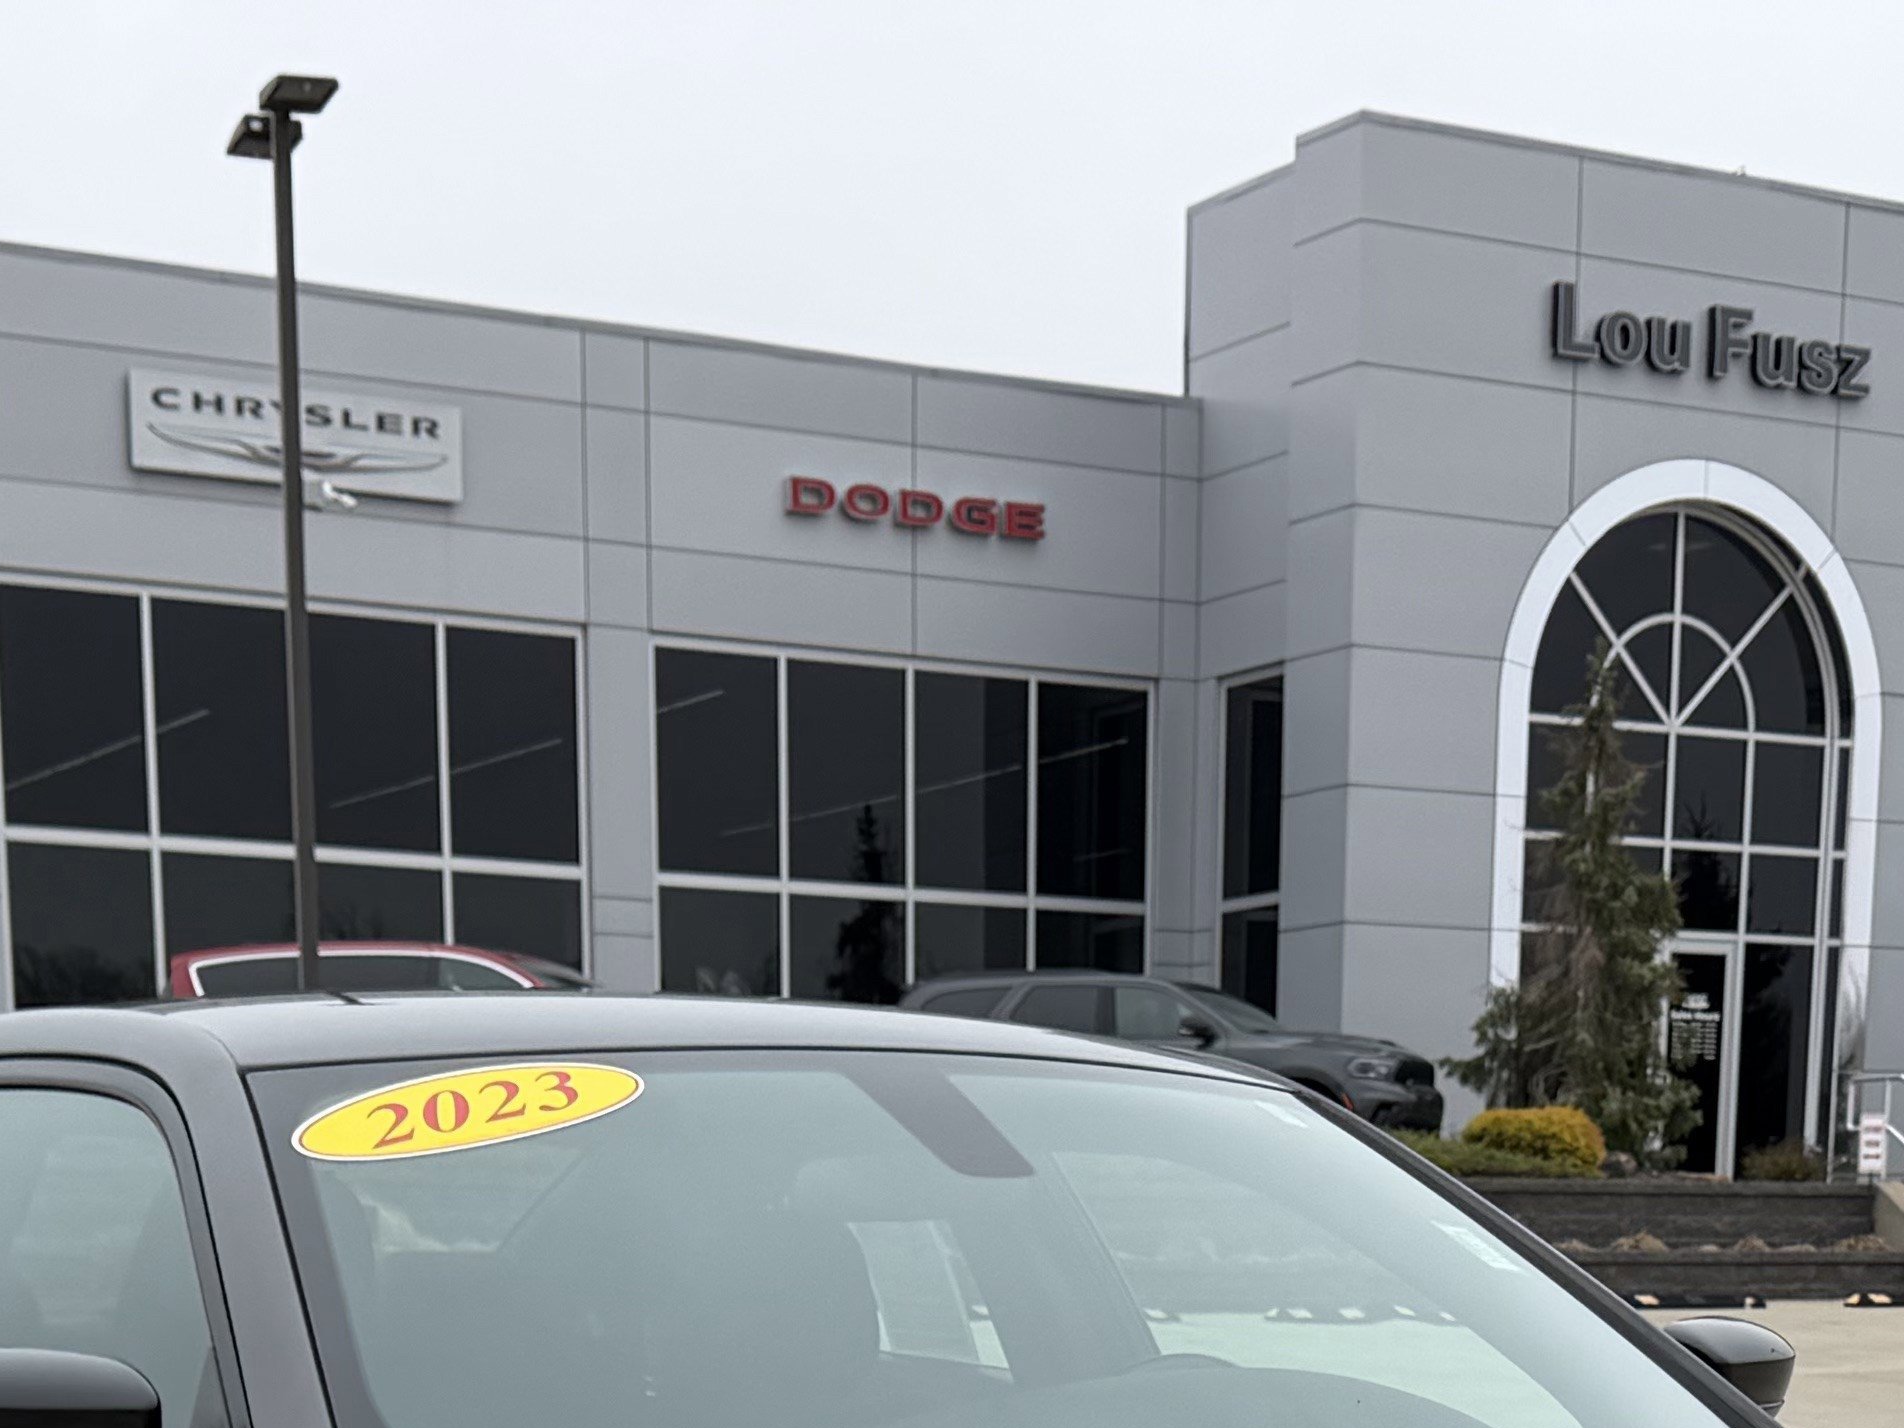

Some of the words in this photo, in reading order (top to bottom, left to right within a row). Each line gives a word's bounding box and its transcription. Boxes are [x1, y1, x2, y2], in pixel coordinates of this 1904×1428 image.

[1552, 280, 1692, 373] Lou
[1707, 303, 1872, 398] Fusz
[785, 476, 1046, 541] DODGE
[367, 1071, 579, 1150] 2023
